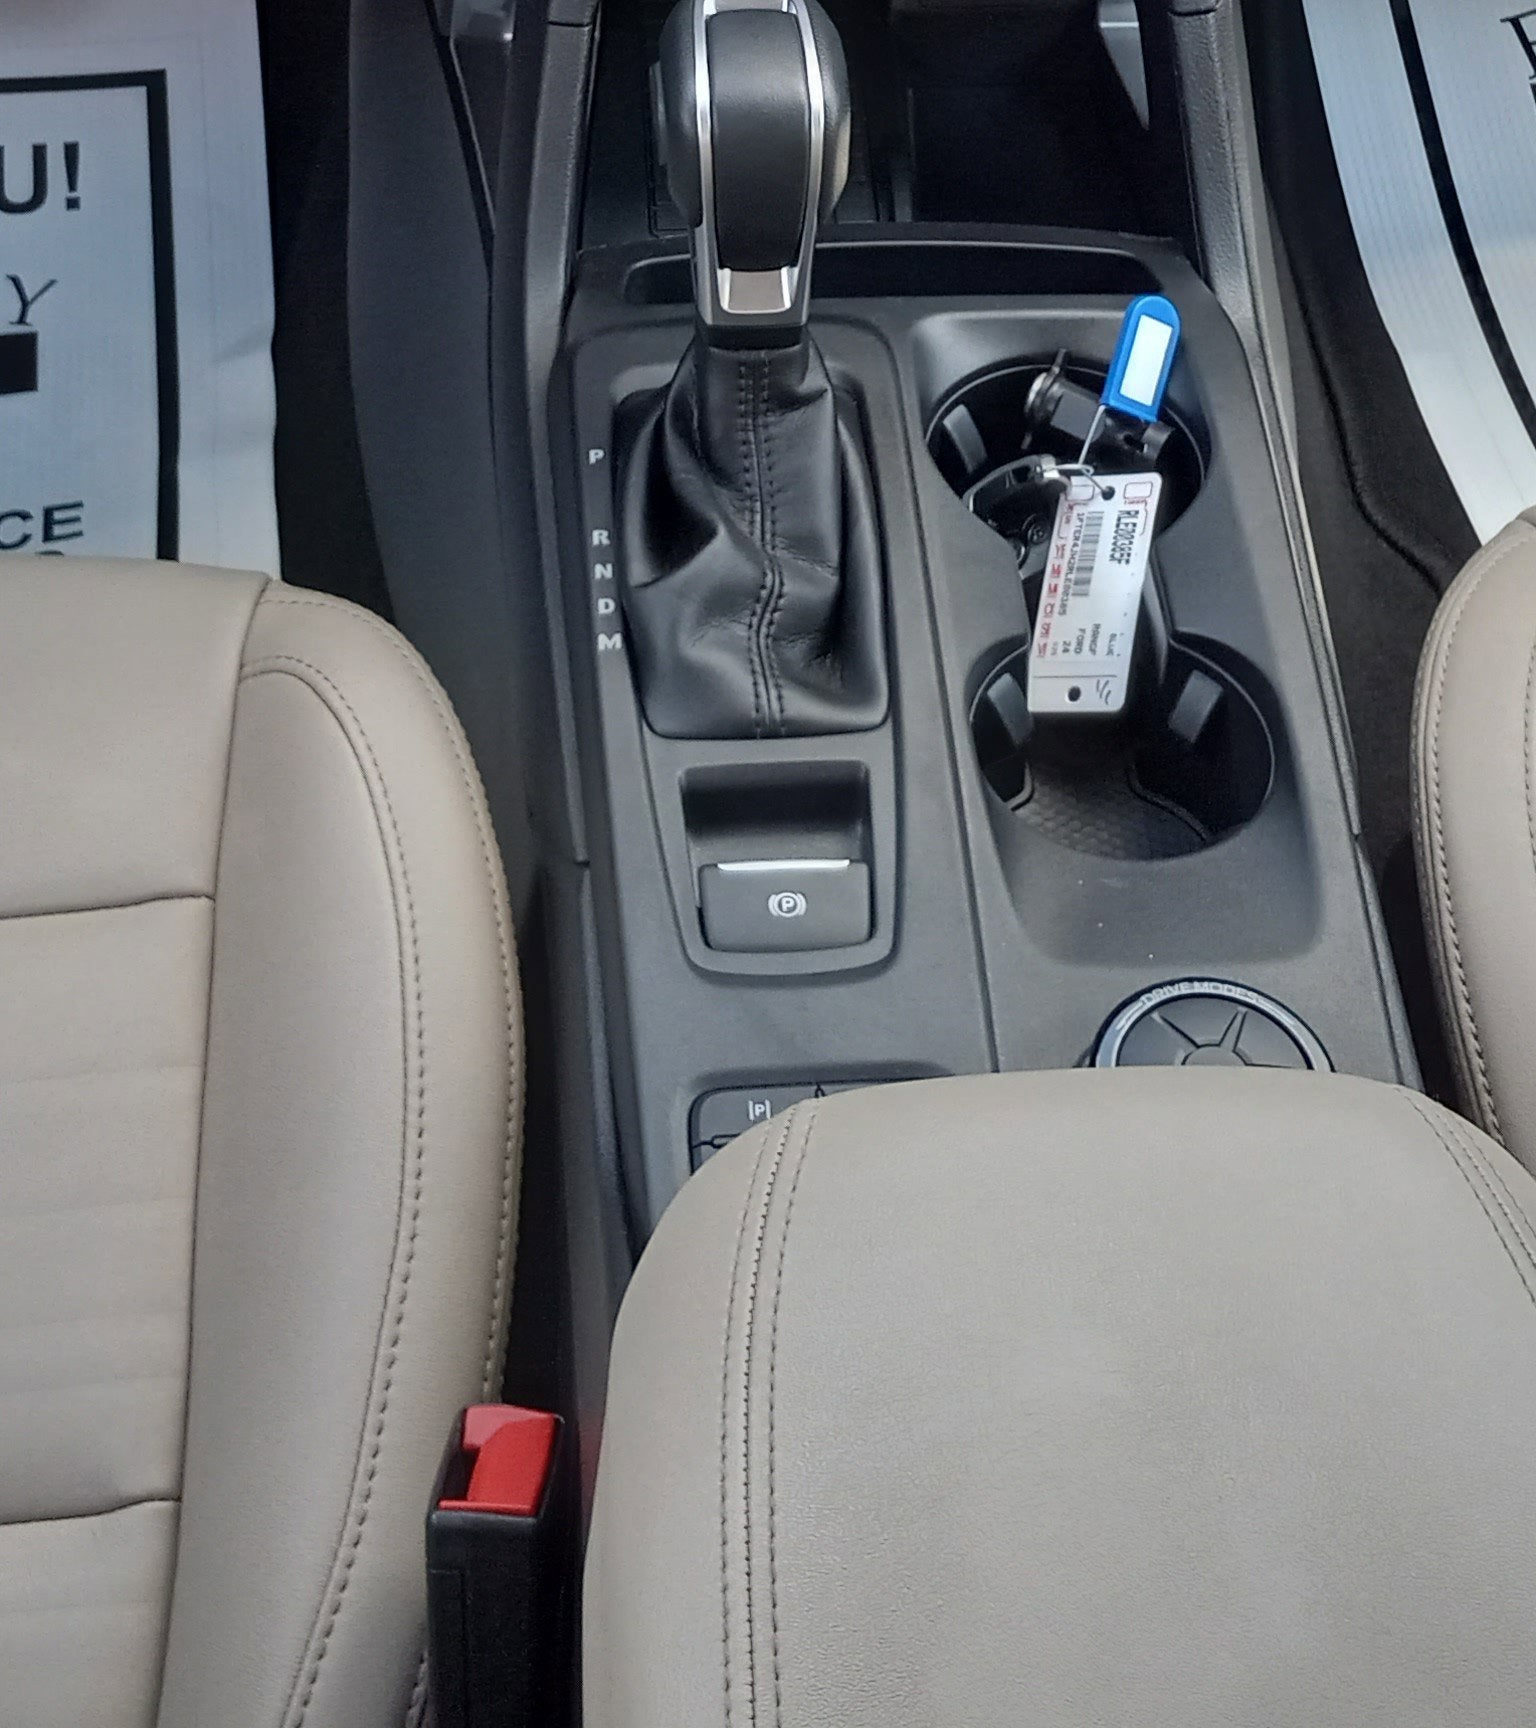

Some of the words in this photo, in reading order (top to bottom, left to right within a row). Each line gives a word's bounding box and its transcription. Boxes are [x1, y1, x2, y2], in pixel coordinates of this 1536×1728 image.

[588, 449, 604, 465] P
[592, 529, 610, 545] R
[595, 564, 613, 579] N
[597, 598, 615, 614] D
[597, 634, 622, 651] M
[1142, 983, 1191, 1007] DRIVE
[1193, 981, 1261, 1003] MODES
